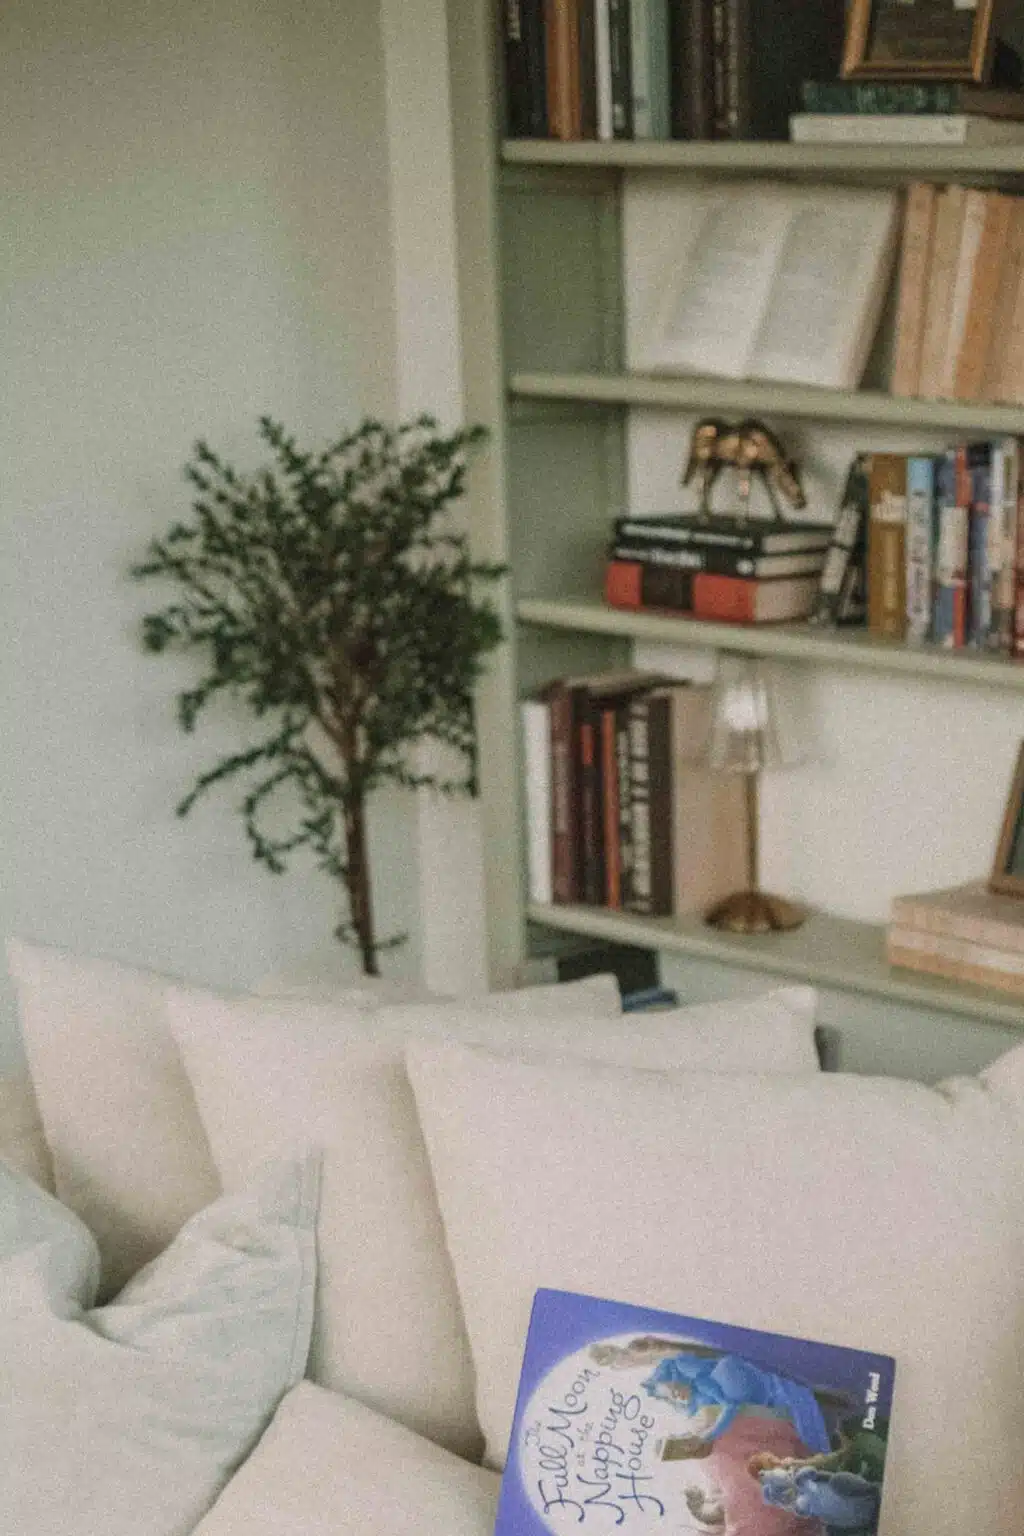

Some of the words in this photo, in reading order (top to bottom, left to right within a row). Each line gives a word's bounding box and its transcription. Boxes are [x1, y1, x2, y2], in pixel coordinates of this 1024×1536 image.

[865, 1371, 881, 1405] Wood
[546, 1368, 601, 1449] Moon
[862, 1406, 877, 1430] Dan
[524, 1420, 542, 1446] The
[576, 1421, 594, 1442] the
[576, 1387, 641, 1525] Napping
[576, 1453, 584, 1467] at
[615, 1414, 665, 1516] House
[537, 1445, 585, 1523] Full
